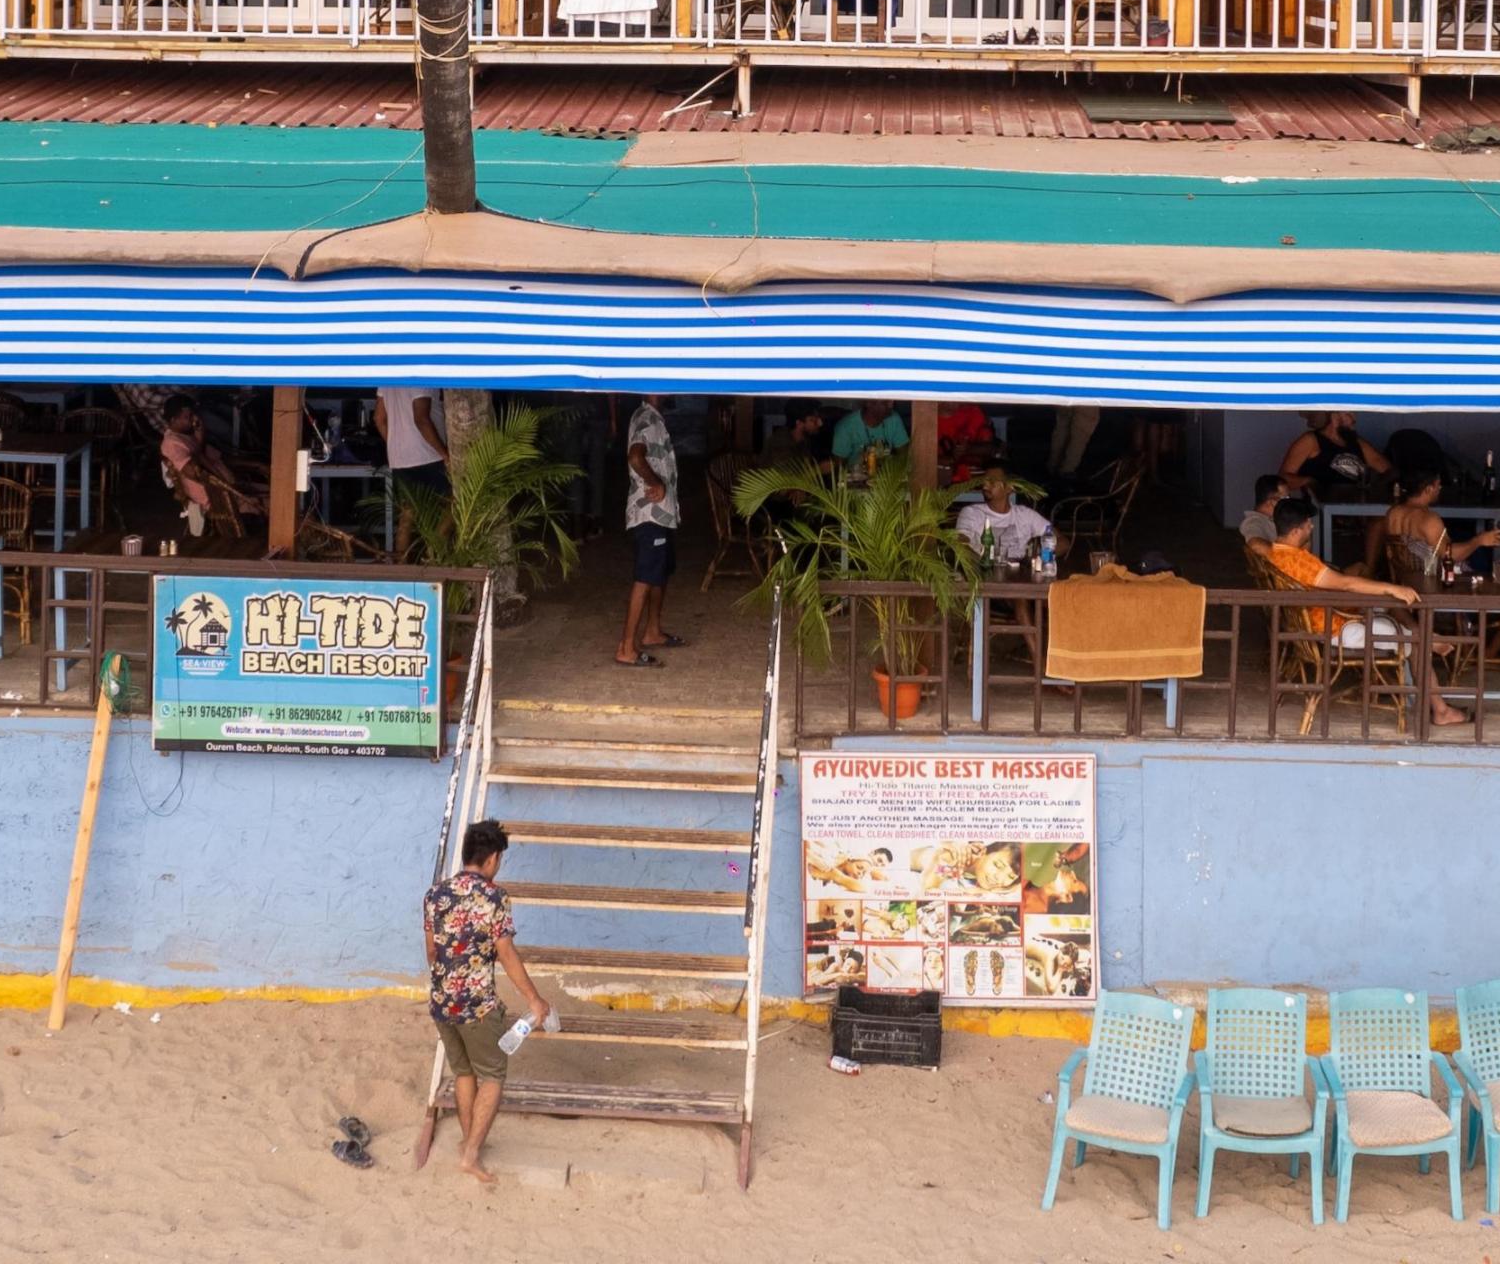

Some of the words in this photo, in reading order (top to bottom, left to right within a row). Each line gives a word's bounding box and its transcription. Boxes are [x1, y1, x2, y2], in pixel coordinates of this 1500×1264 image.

[245, 594, 425, 650] HI-TIDE
[242, 652, 325, 675] BEACH
[330, 654, 427, 677] RESORT
[180, 706, 197, 718] +91
[268, 707, 285, 720] +91
[289, 708, 342, 722] 8629052842
[357, 710, 375, 722] +91
[378, 710, 432, 724] 7507687136
[206, 742, 234, 751] Ourem
[236, 743, 265, 753] Beach,
[267, 744, 303, 754] Palolem,
[304, 745, 330, 754] South
[331, 746, 349, 755] Goa
[356, 747, 386, 756] 403702
[813, 760, 927, 779] AYURVEDIC
[934, 760, 985, 778] BEST
[992, 760, 1087, 780] MASSAGE
[940, 783, 989, 791] Massage
[979, 791, 1050, 799] MASSAGE
[807, 830, 834, 838] CLEAN
[866, 830, 894, 839] CLEAN
[938, 831, 965, 839] CLEAN
[966, 831, 1006, 839] MASSAGE
[1034, 831, 1061, 840] CLEAN
[1062, 831, 1085, 840] HAND
